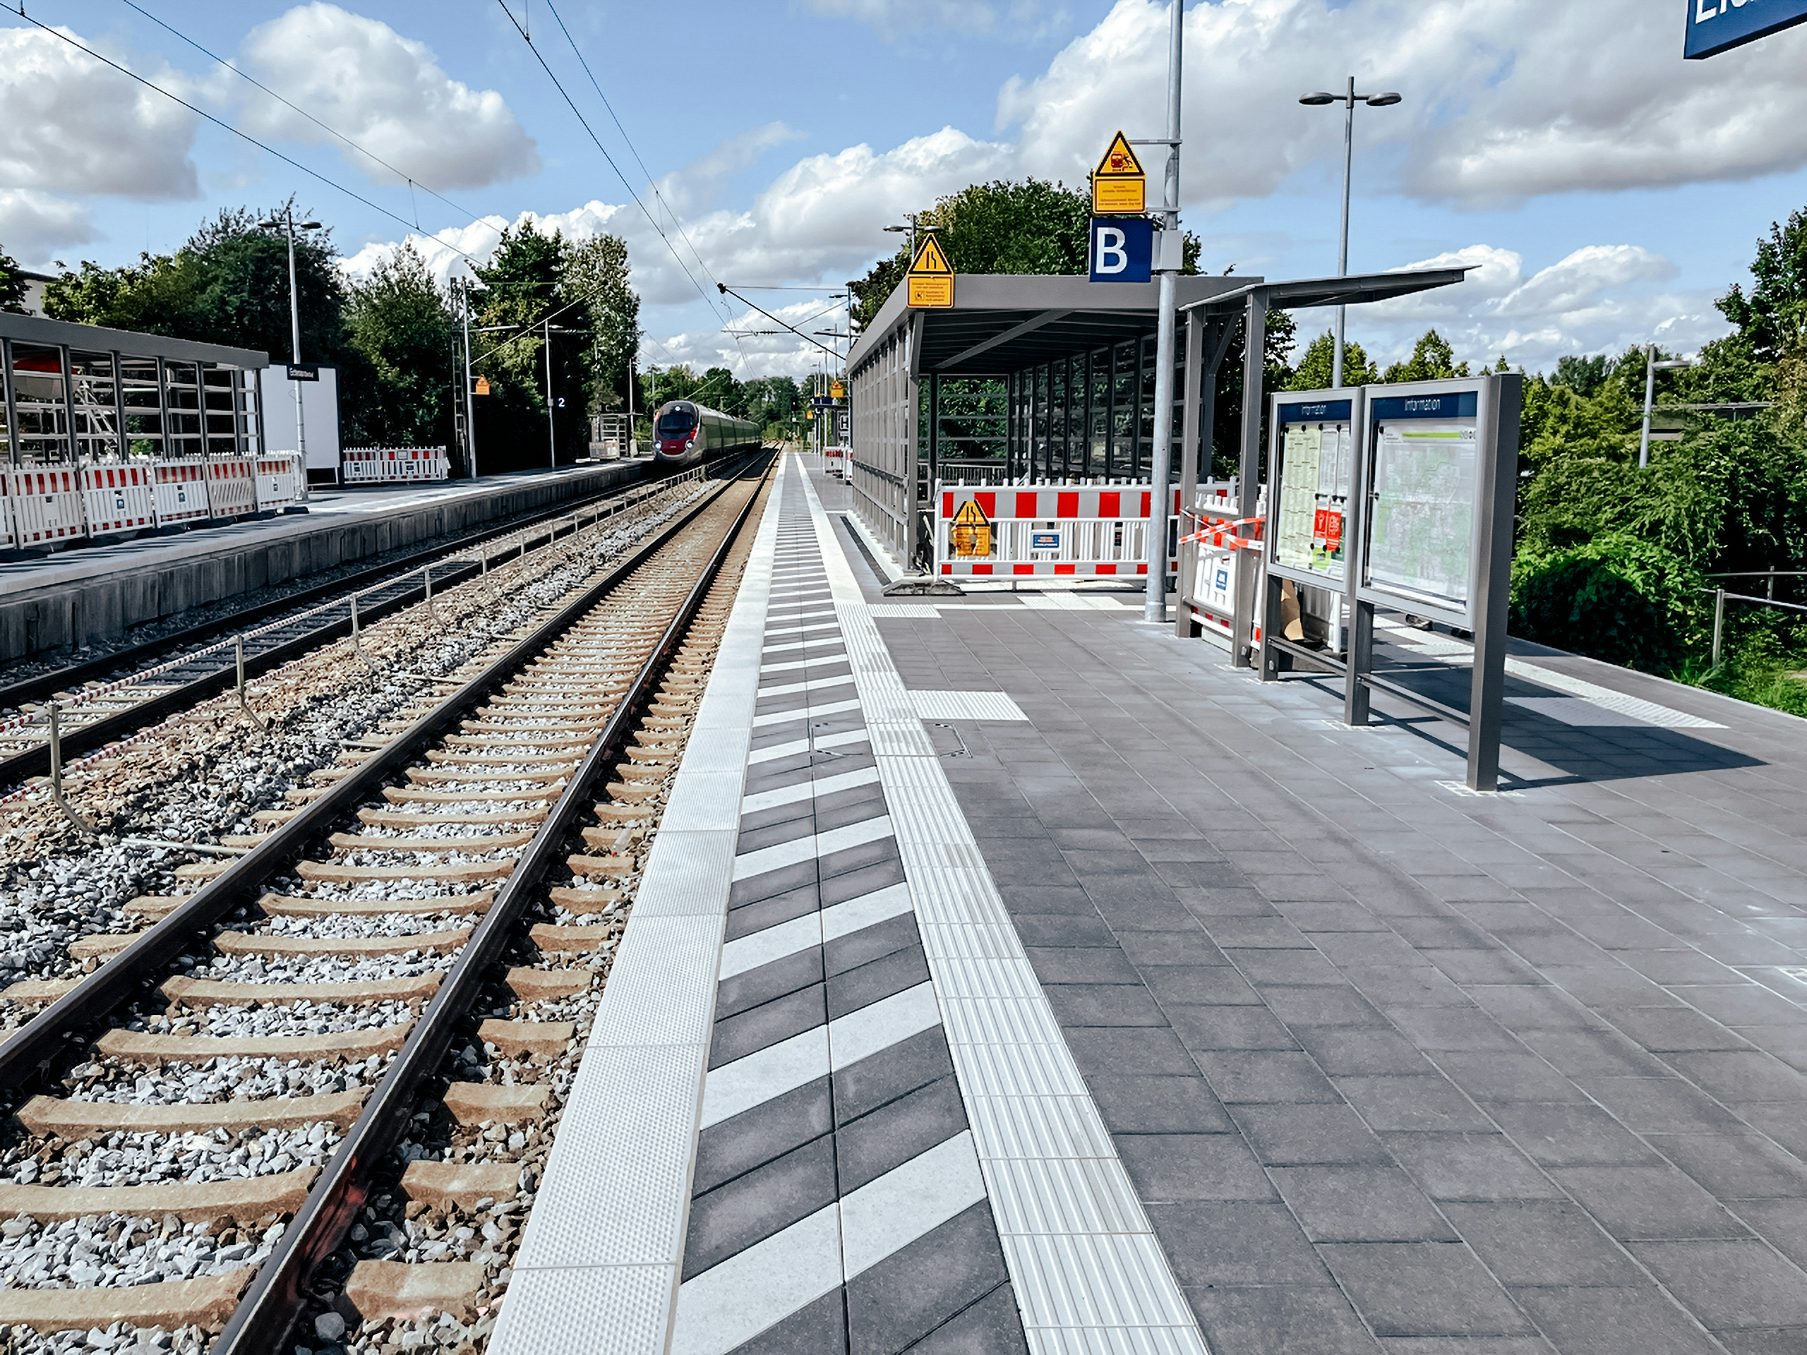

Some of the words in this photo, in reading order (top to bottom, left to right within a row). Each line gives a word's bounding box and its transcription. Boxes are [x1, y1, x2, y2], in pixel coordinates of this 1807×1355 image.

[1096, 227, 1128, 274] B
[558, 397, 565, 408] 2
[1404, 399, 1441, 412] Information
